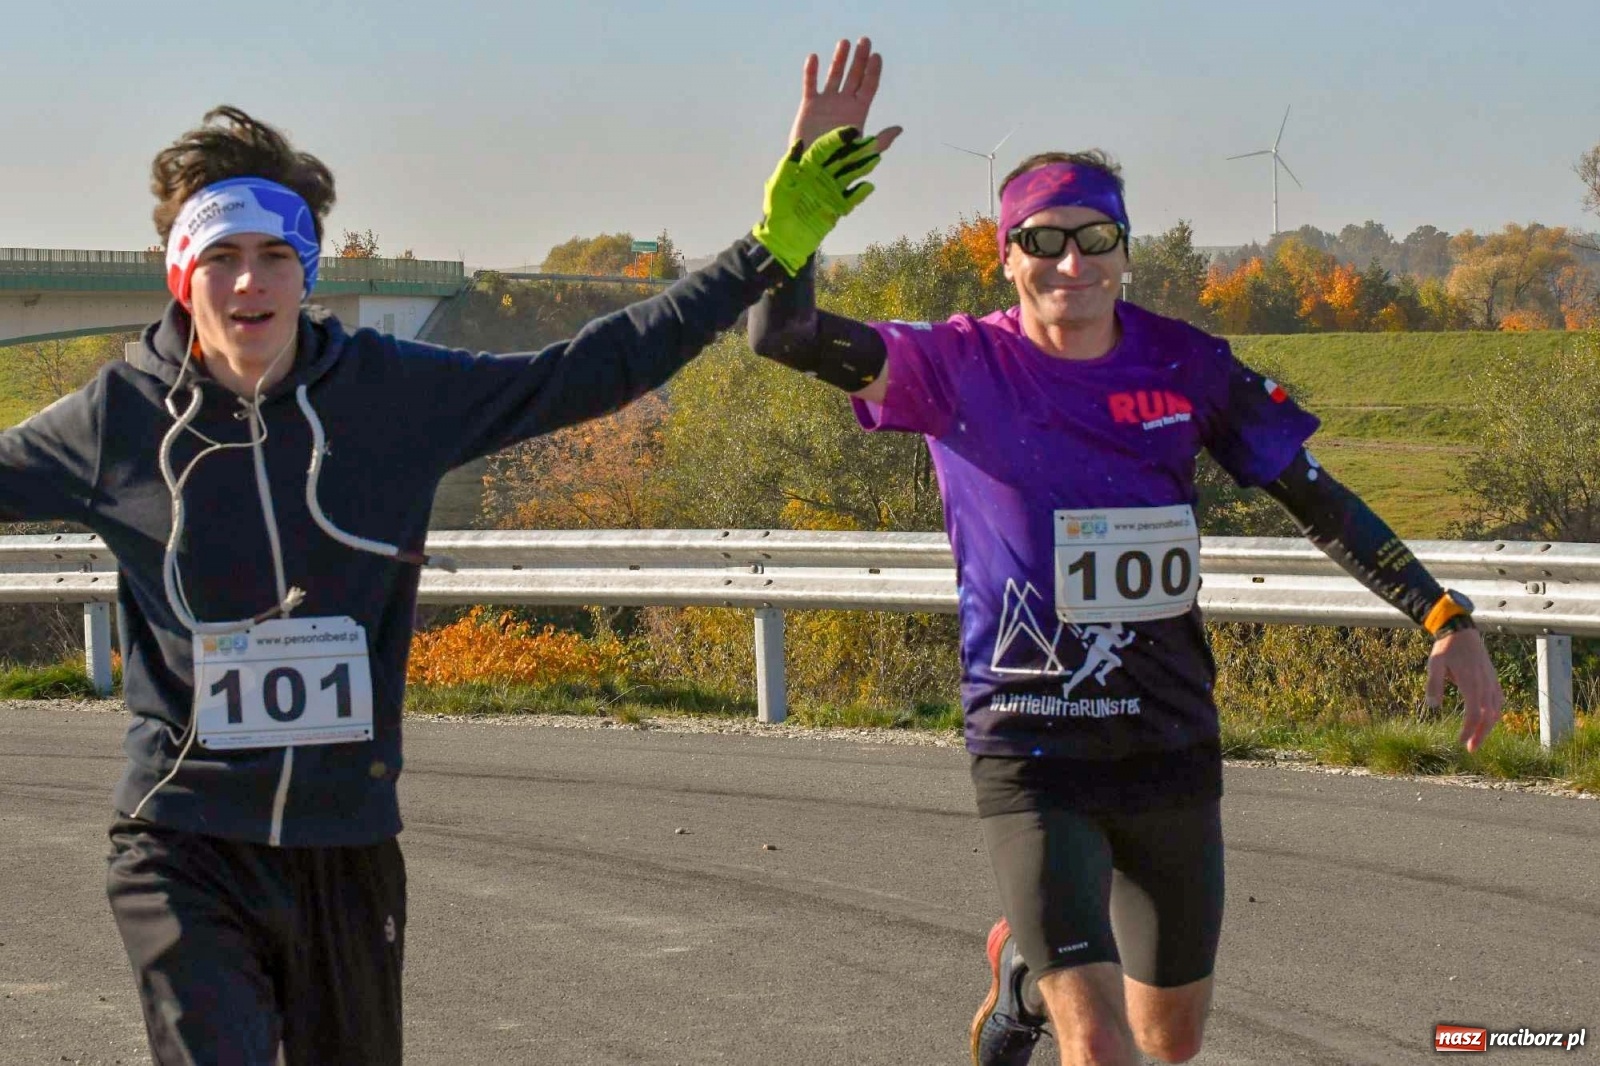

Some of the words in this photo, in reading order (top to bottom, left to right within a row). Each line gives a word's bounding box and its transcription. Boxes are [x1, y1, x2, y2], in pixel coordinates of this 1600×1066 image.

[1108, 390, 1192, 423] RUN
[1068, 547, 1192, 601] 100
[256, 631, 359, 647] www.personalbest.pl
[210, 663, 352, 724] 101
